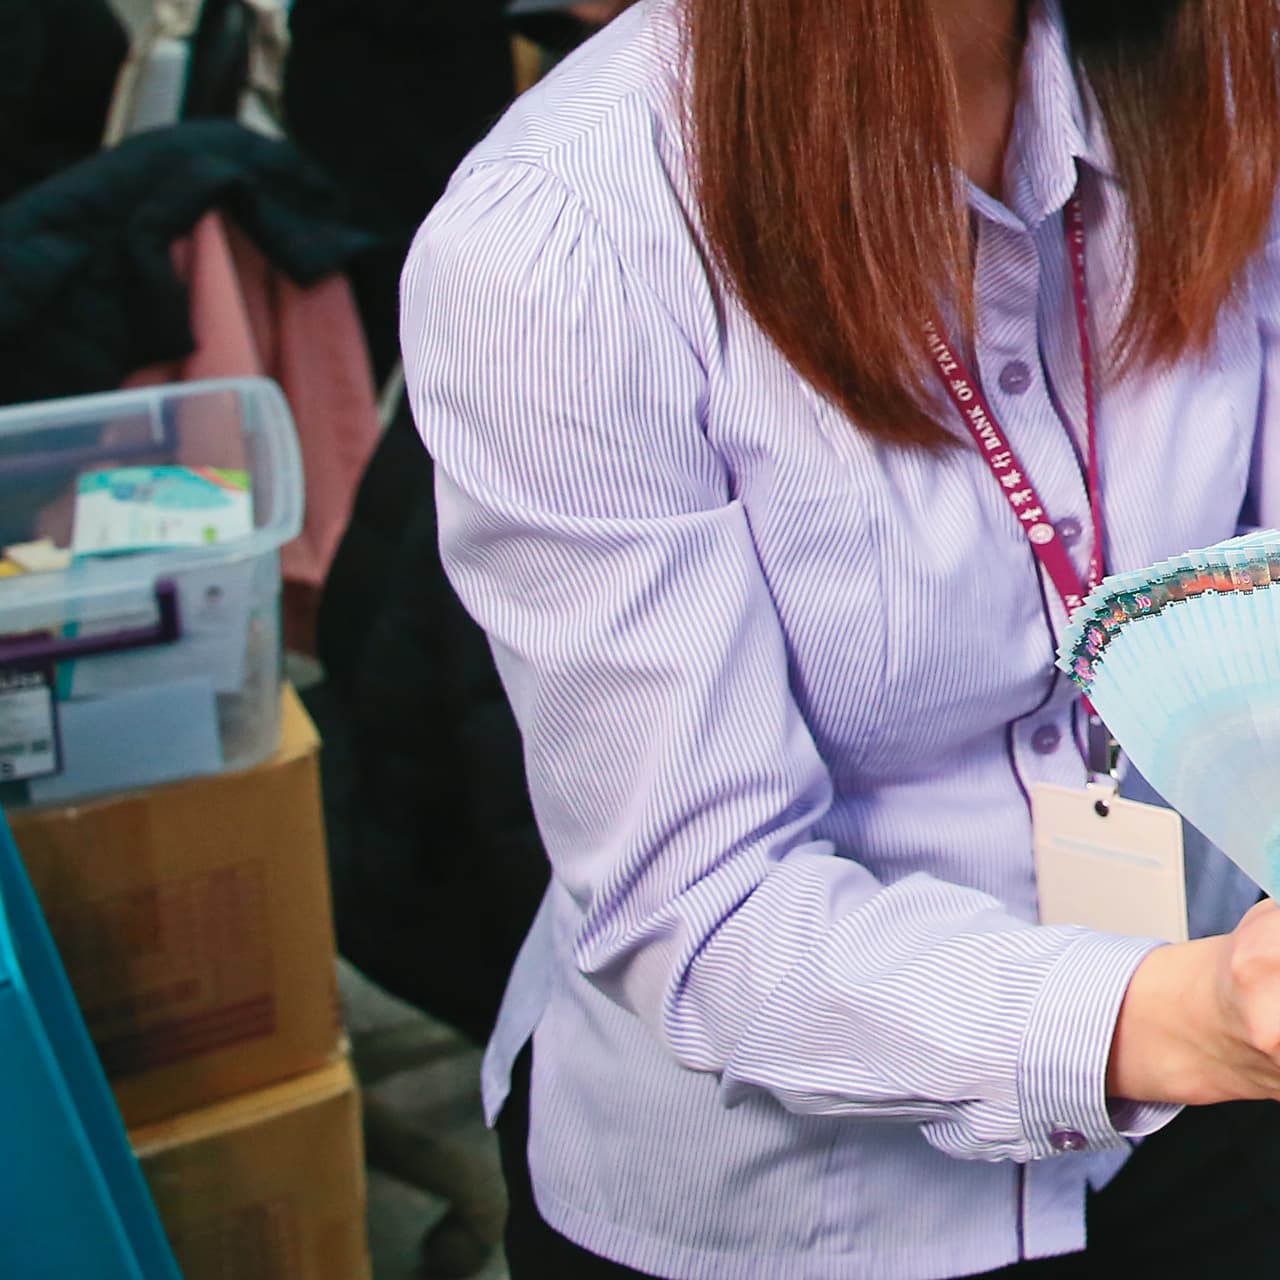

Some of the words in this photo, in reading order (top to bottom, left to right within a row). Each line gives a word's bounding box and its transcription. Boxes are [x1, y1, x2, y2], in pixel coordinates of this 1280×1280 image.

[922, 321, 959, 376] TAIWA
[950, 379, 973, 402] OF
[966, 405, 1002, 451] BANK
